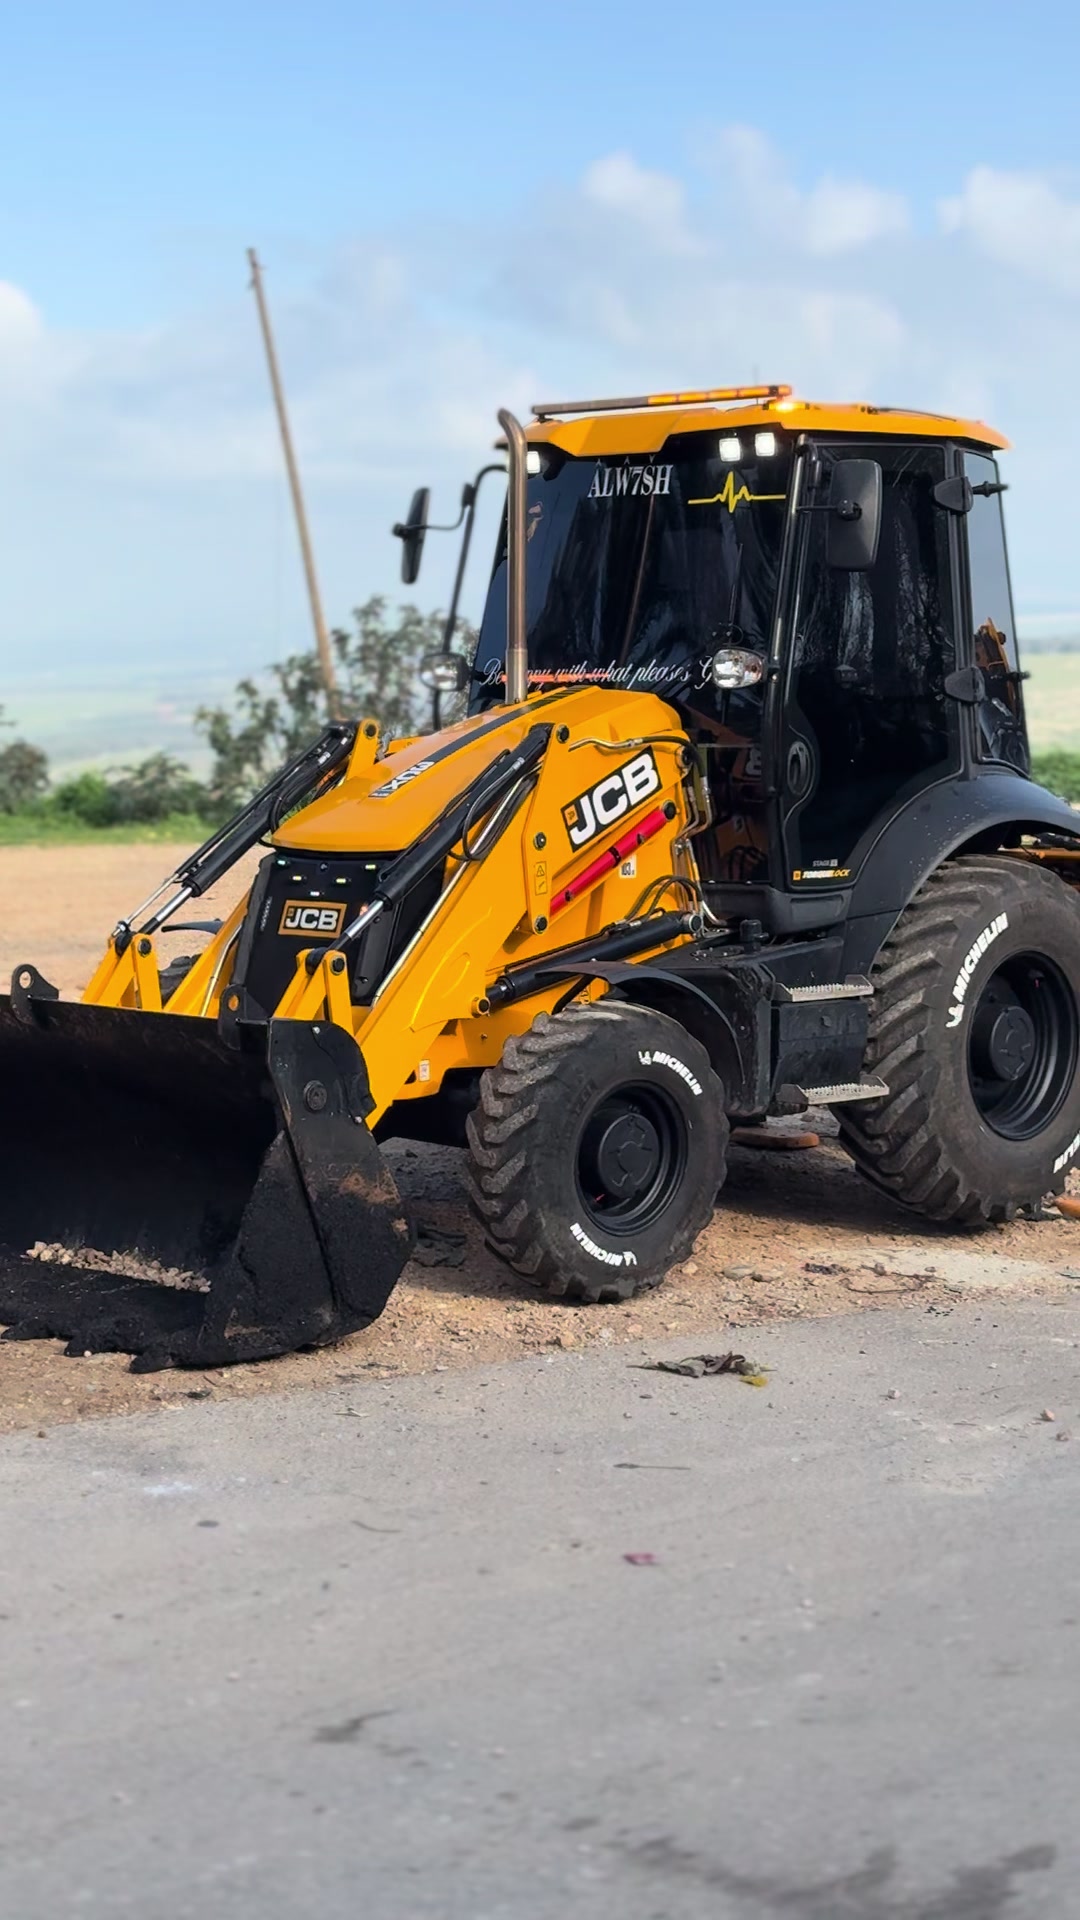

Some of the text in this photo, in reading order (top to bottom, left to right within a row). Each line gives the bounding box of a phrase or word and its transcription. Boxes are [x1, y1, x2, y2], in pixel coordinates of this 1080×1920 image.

[568, 751, 660, 847] JCB
[285, 907, 339, 931] JCB
[952, 911, 1010, 1003] MICHELIN
[652, 1051, 704, 1097] MICHELIN
[569, 1222, 623, 1267] MICHELIN
